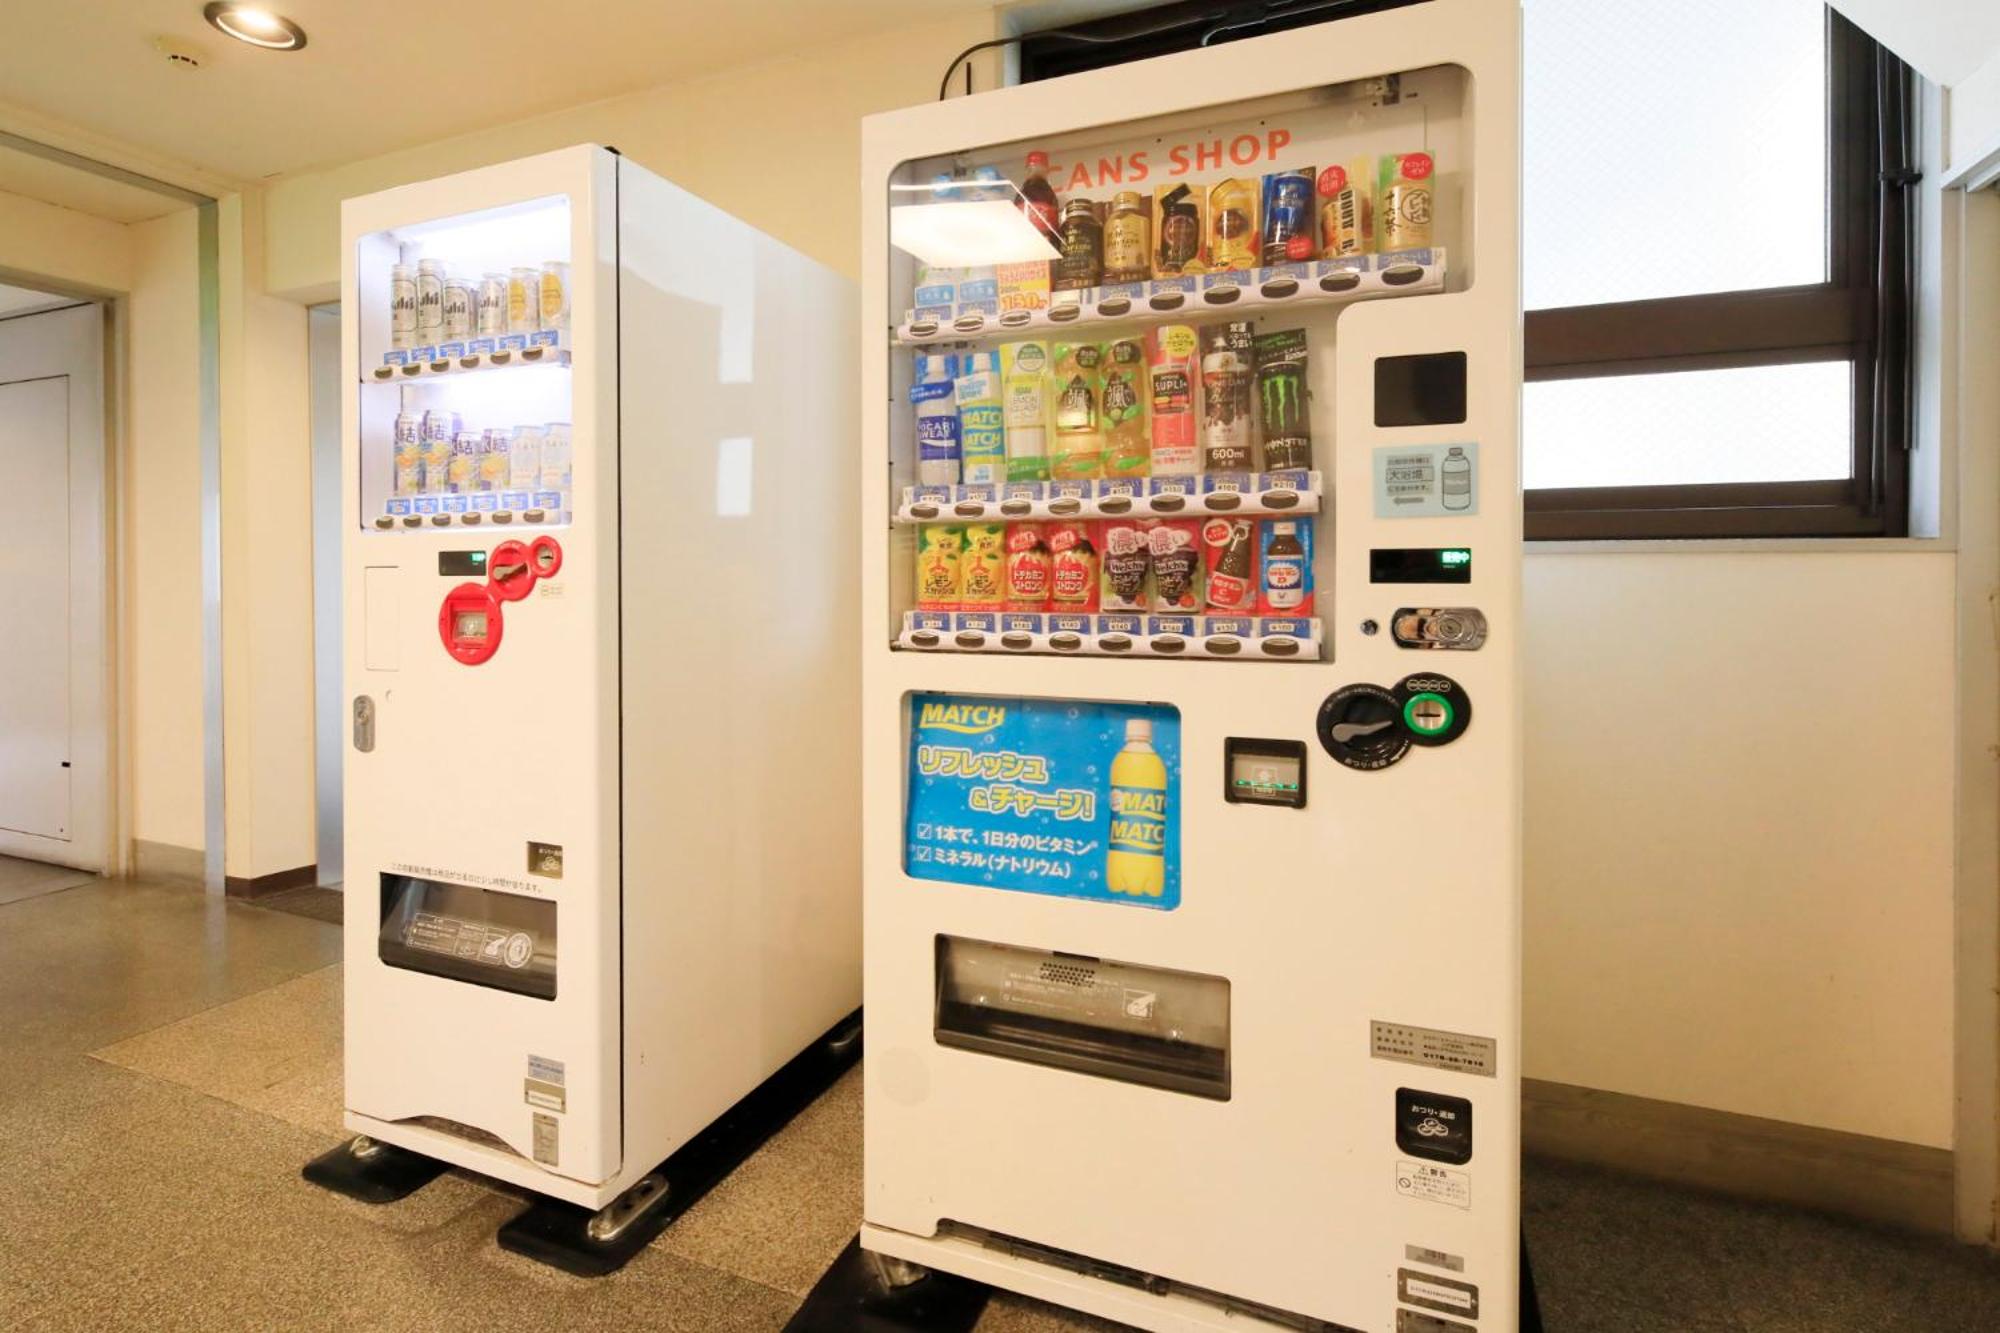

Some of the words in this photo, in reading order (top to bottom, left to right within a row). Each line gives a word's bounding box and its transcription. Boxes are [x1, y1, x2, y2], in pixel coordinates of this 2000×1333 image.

[1169, 129, 1292, 176] SHOP
[920, 704, 1006, 730] MATCH
[919, 746, 1047, 783] リフレッシュ
